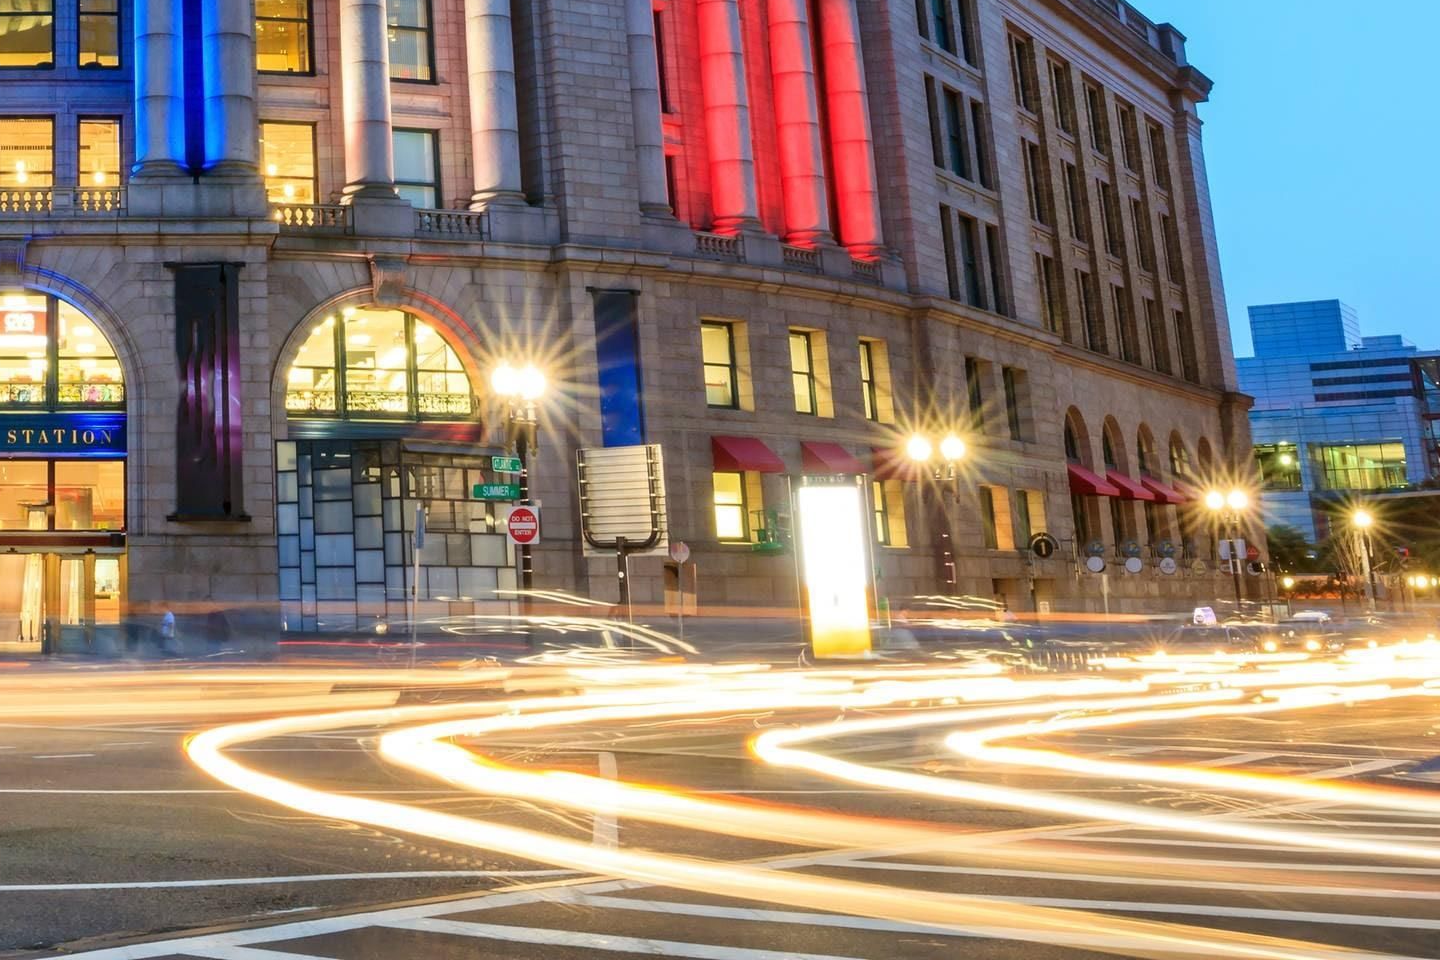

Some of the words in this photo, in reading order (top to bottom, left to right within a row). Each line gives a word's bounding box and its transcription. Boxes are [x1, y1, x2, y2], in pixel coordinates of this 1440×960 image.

[7, 429, 112, 445] STATION
[482, 485, 510, 497] SUMMER
[1040, 541, 1046, 555] 1
